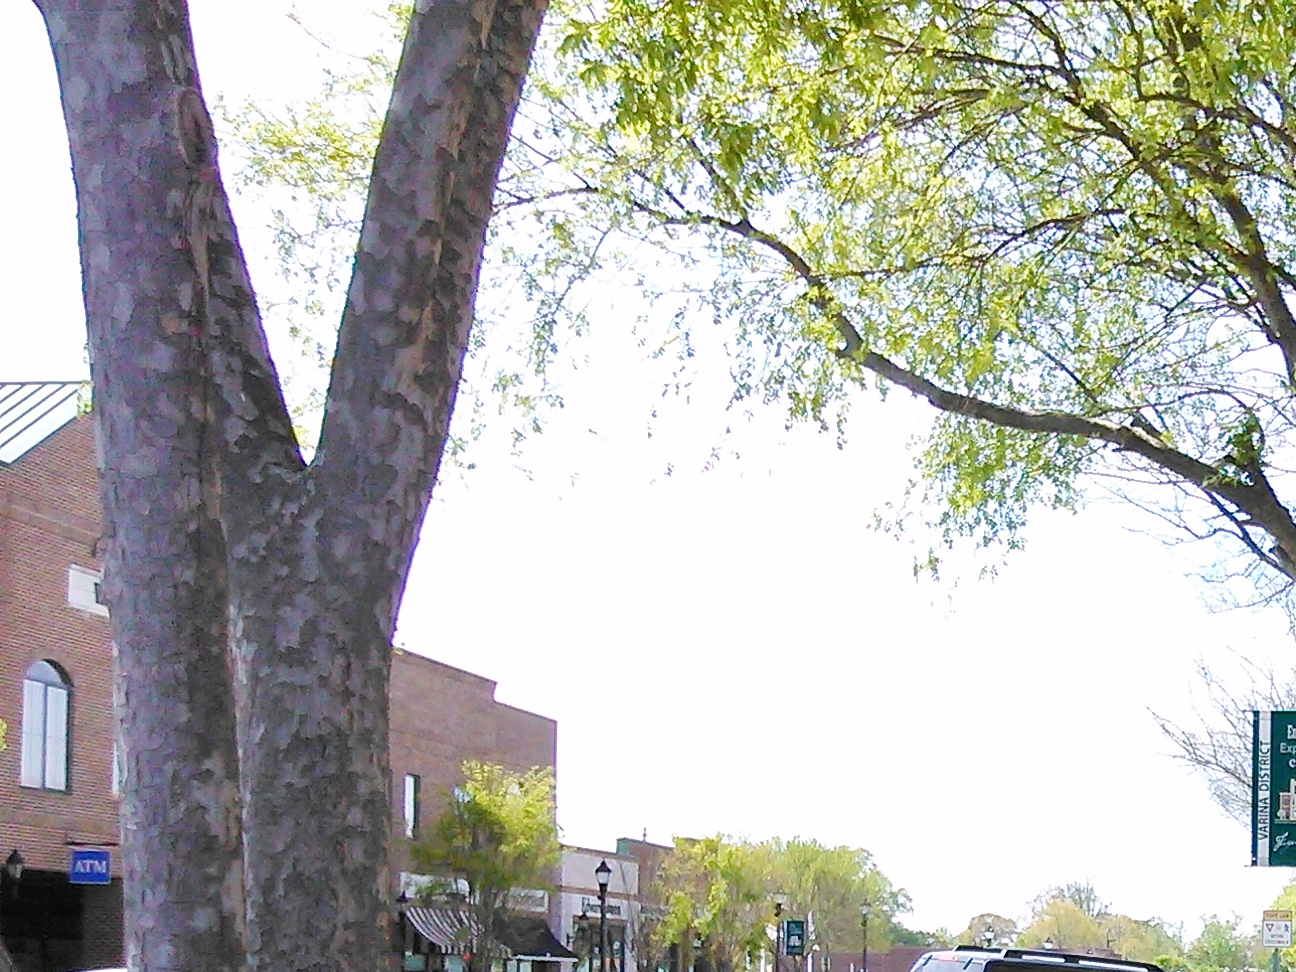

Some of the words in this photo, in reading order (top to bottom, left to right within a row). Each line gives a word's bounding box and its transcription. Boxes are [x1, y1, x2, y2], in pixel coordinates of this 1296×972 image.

[1258, 740, 1270, 792] DISTRICT
[1258, 796, 1270, 841] VARINA
[74, 860, 107, 873] ATM
